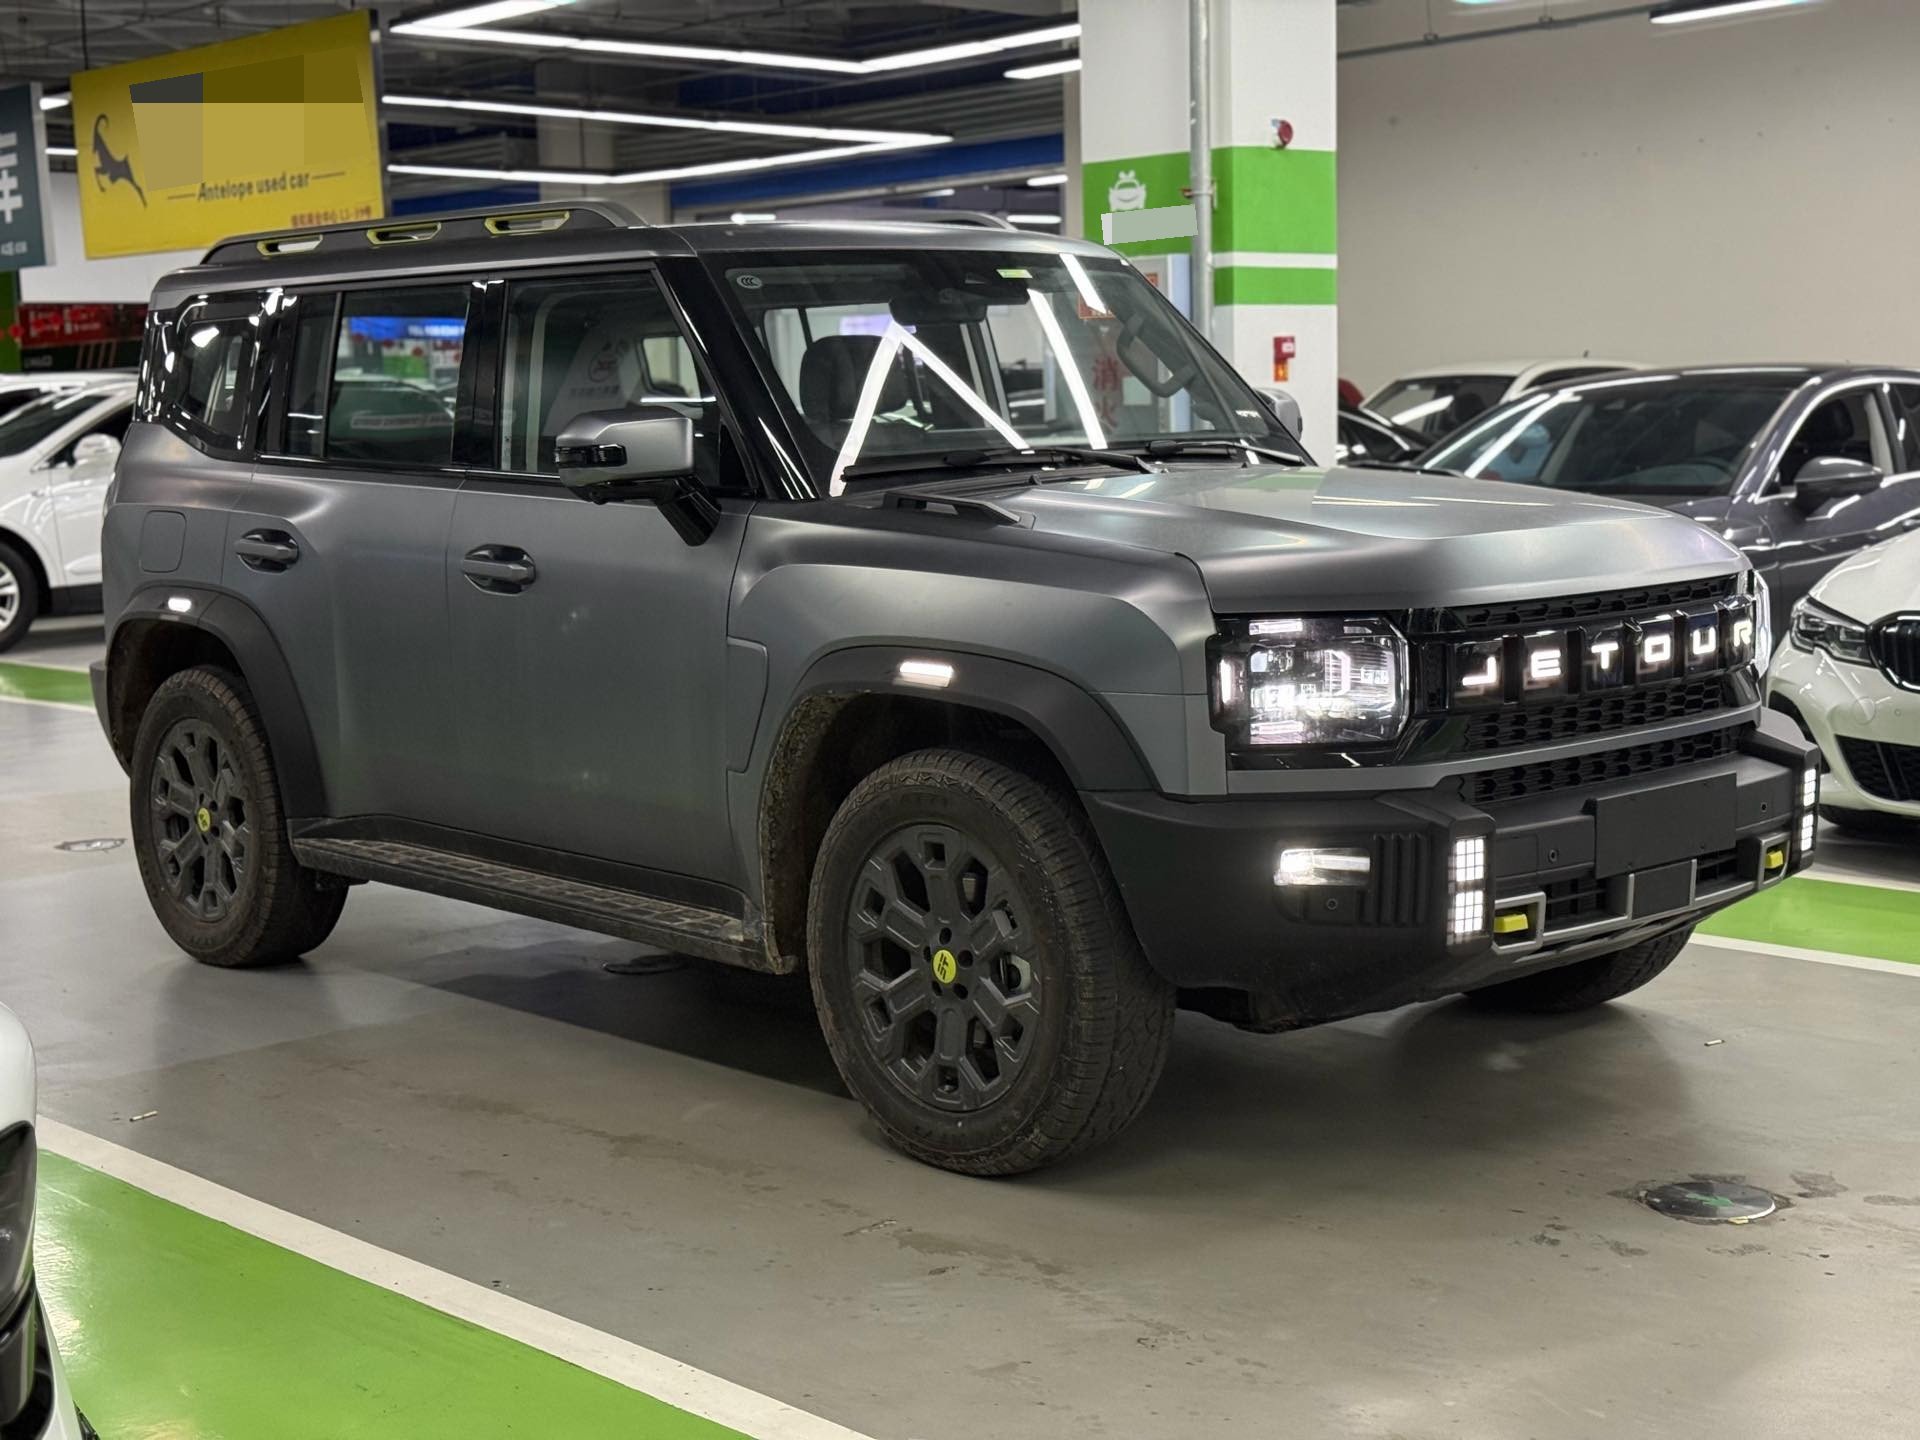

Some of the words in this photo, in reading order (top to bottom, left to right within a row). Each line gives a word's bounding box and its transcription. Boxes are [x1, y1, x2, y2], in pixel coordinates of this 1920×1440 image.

[198, 180, 253, 202] Antelope
[256, 171, 287, 193] used
[290, 172, 310, 190] car
[1462, 620, 1751, 687] JETOUR
